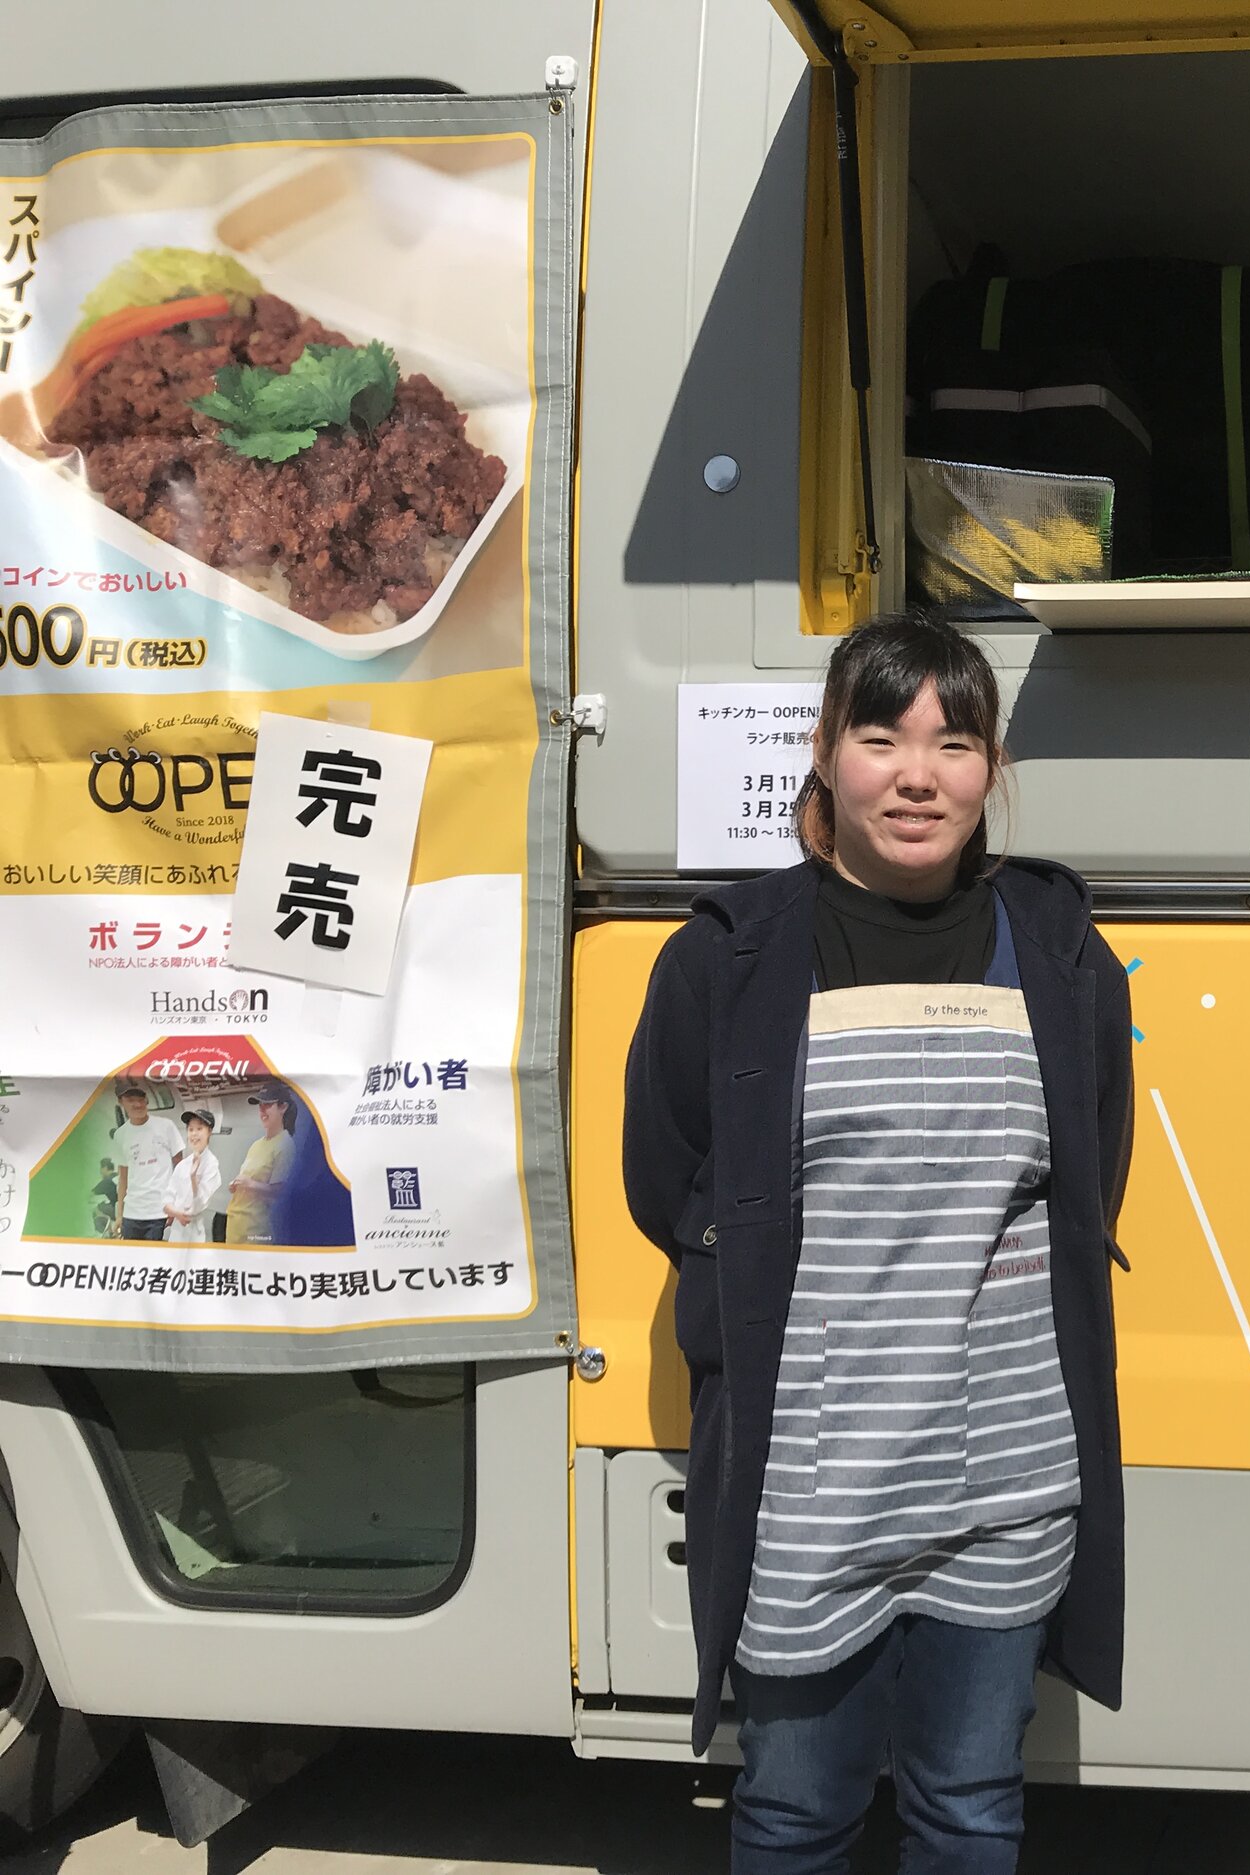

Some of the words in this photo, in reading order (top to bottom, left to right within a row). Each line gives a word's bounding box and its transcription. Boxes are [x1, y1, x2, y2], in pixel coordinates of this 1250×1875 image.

[0, 566, 187, 593] コインでおいしい
[698, 706, 769, 720] キッチンカー
[176, 816, 204, 828] Since
[208, 815, 234, 826] 2018
[727, 827, 757, 839] 11:30
[274, 748, 382, 952] 完売
[924, 1005, 938, 1016] By
[941, 1004, 960, 1015] the
[963, 1006, 988, 1018] style
[226, 1014, 269, 1024] TOKYO
[362, 1058, 469, 1097] 障がい者
